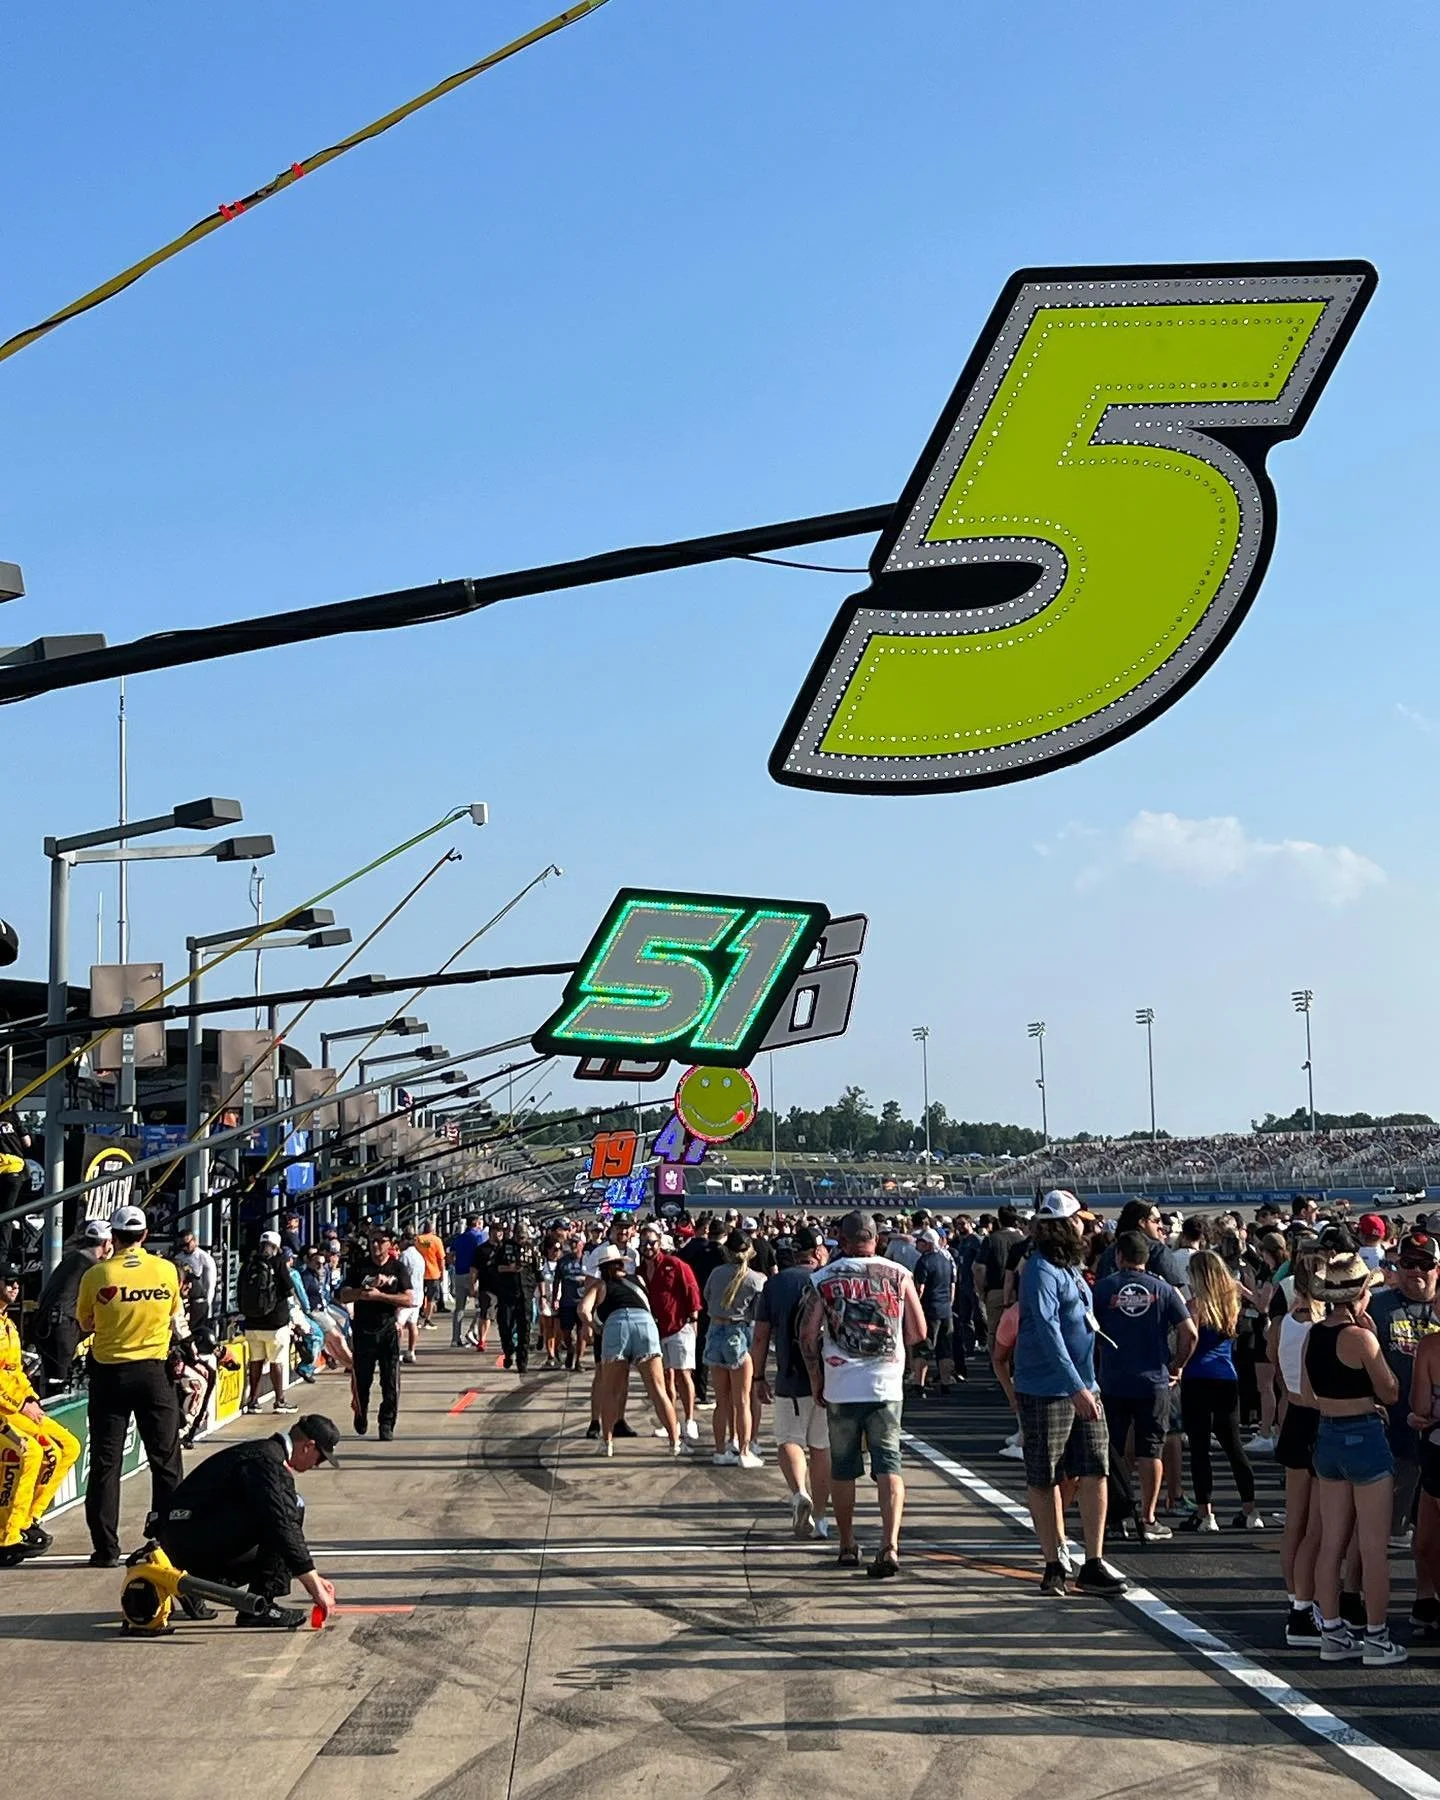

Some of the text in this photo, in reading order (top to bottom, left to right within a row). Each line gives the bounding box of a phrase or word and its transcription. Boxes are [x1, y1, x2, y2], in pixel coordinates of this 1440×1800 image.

[776, 268, 1370, 788] 5
[551, 900, 813, 1050] 51
[590, 1130, 637, 1179] 19
